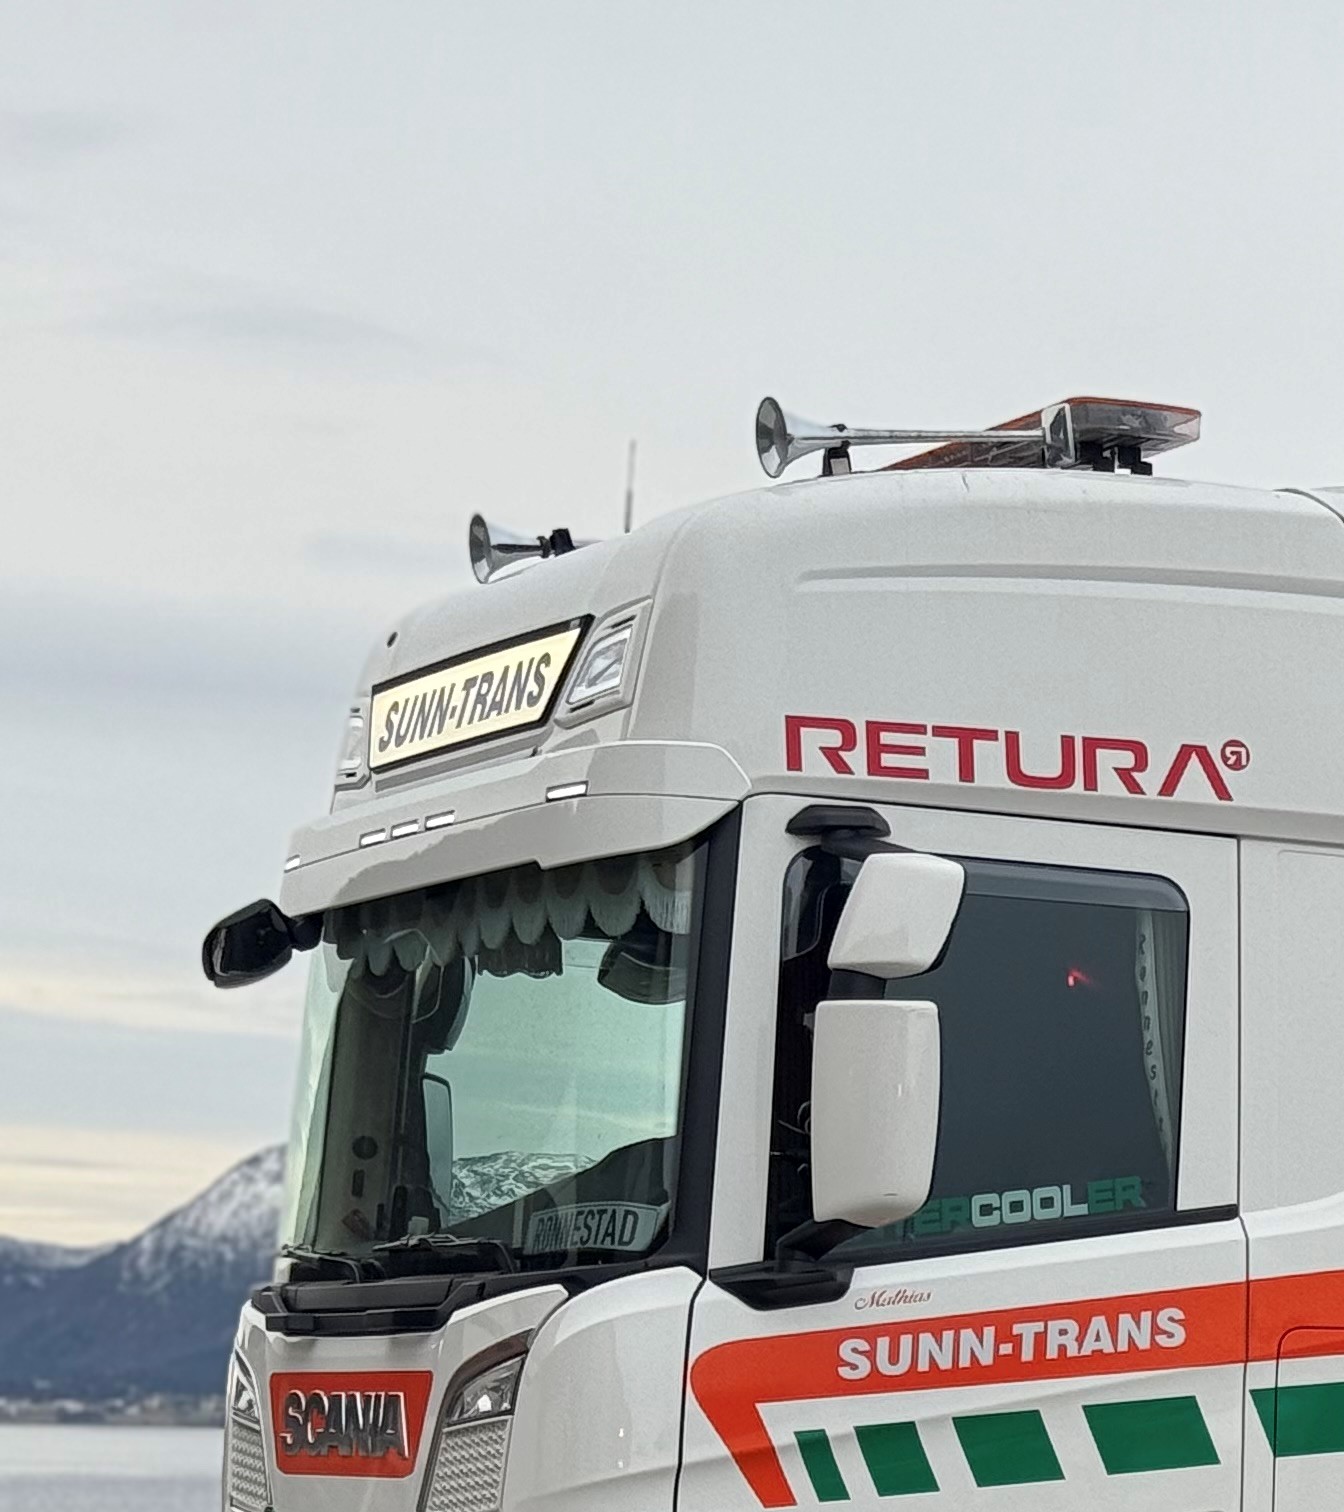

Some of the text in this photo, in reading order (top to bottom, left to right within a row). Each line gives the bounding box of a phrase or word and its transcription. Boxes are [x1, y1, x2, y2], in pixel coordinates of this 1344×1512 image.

[377, 651, 555, 754] SUNN-TRANS
[784, 714, 1233, 801] RETURA
[837, 1306, 1188, 1381] SUNN-TRANS
[279, 1389, 411, 1459] SCANIA
